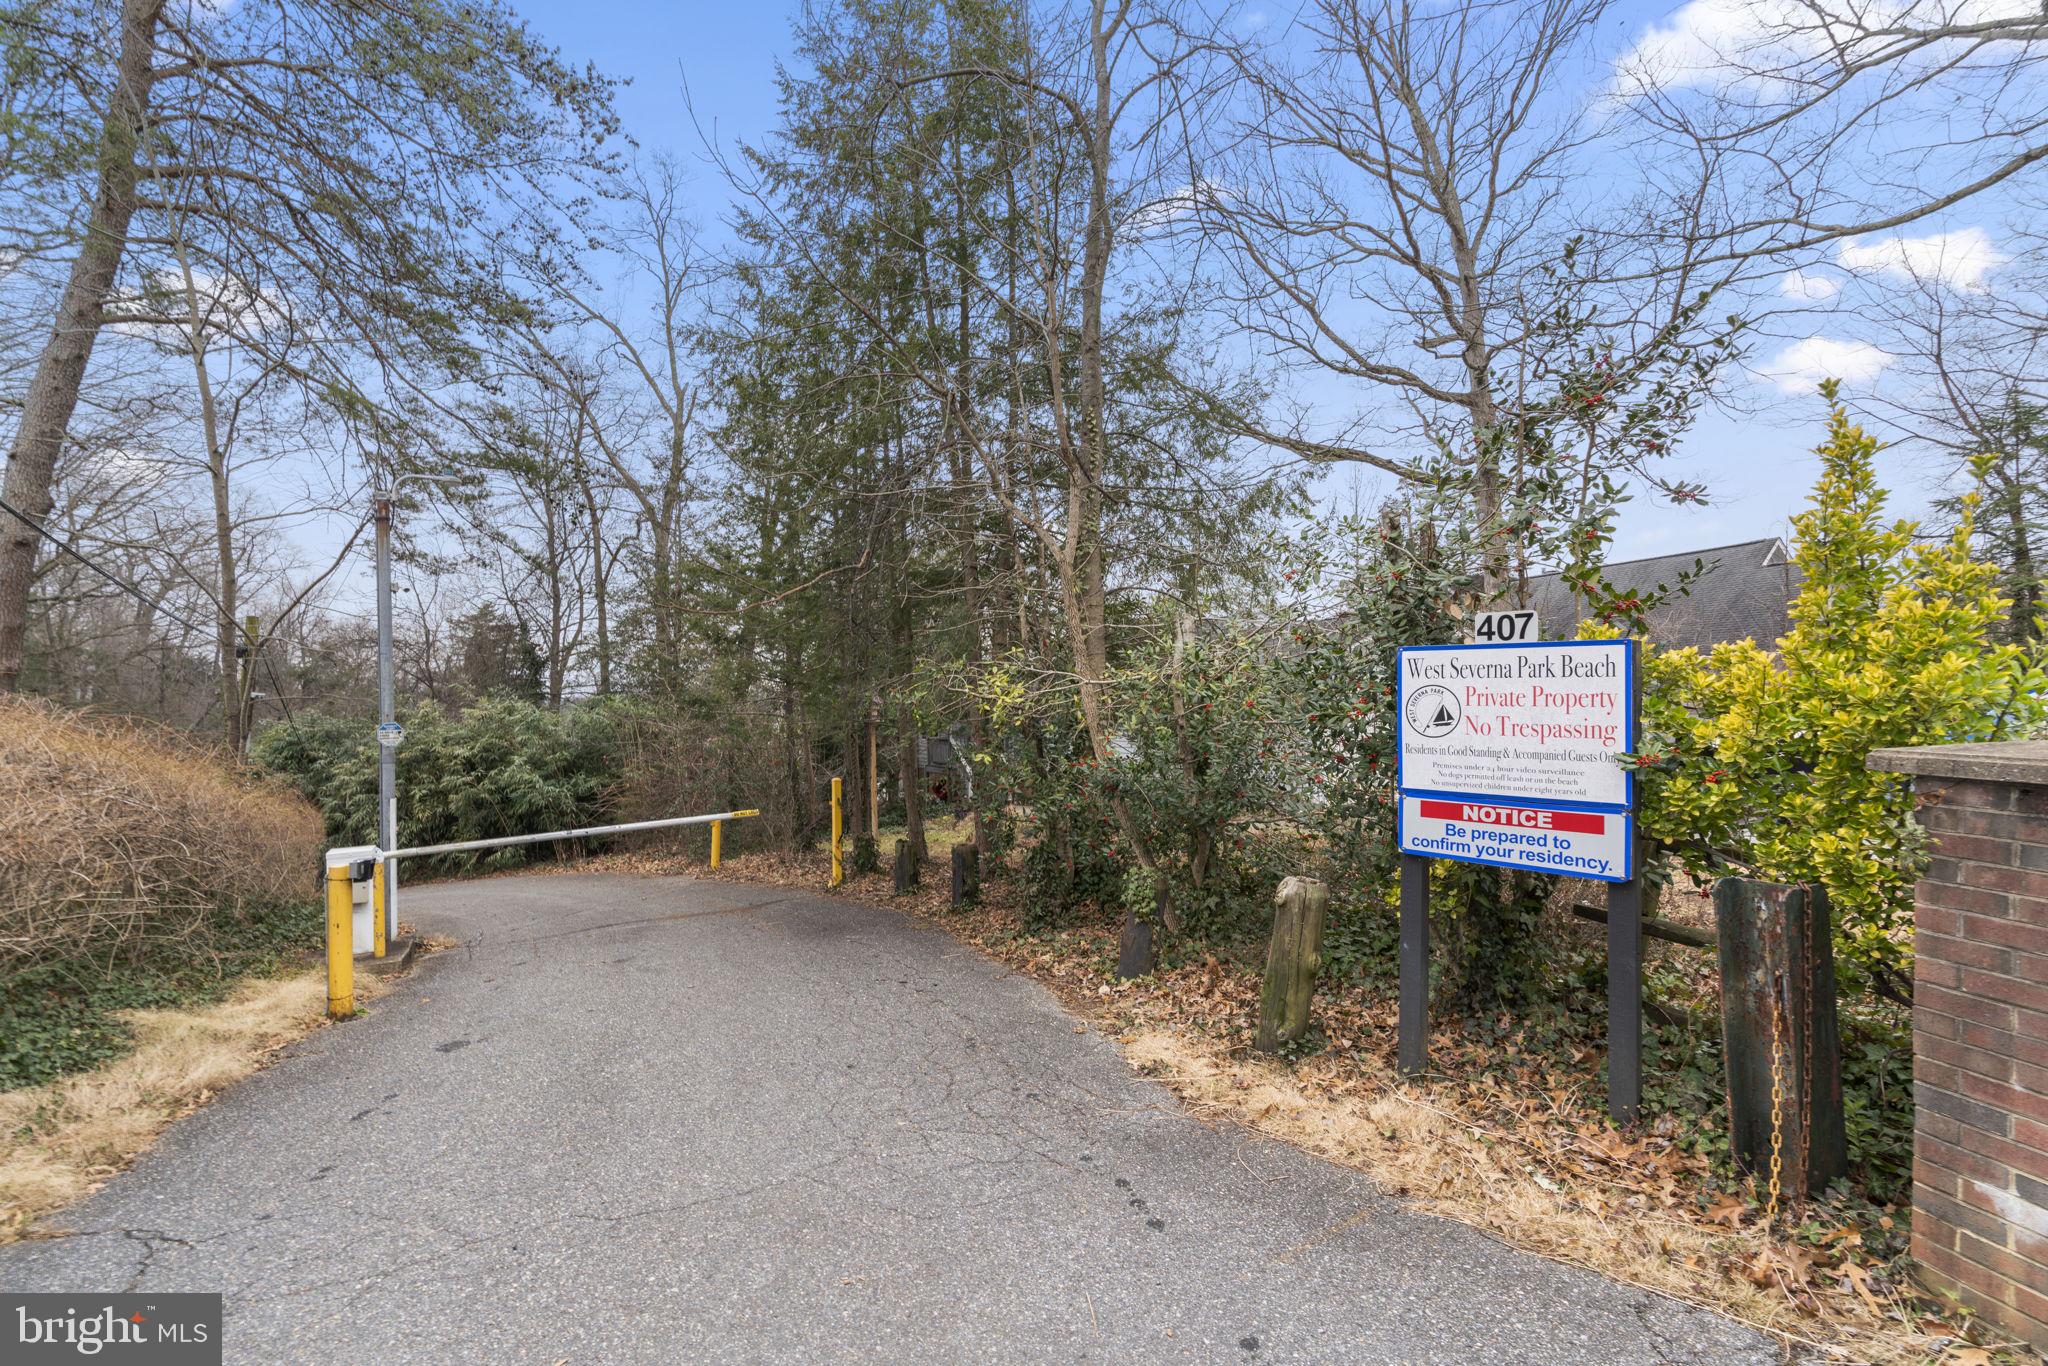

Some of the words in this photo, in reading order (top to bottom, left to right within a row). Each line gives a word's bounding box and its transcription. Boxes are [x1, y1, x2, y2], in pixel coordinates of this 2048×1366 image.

[1477, 613, 1534, 641] 407
[1407, 657, 1446, 679] West
[1450, 656, 1512, 679] Severna
[1517, 655, 1556, 678] Park
[1561, 654, 1616, 678] Beach
[1465, 685, 1526, 708] Private
[1531, 685, 1617, 715] Property
[1465, 715, 1491, 736] No
[1496, 715, 1618, 747] Trespassing
[1405, 743, 1437, 755] Residents
[1439, 744, 1447, 755] in
[1447, 745, 1468, 757] Good
[1469, 745, 1502, 761] Standing
[1503, 747, 1510, 759] &
[1513, 748, 1566, 763] Accompanied
[1568, 750, 1597, 762] Guests
[1432, 762, 1462, 770] Premises
[1448, 771, 1463, 779] dogs
[1484, 782, 1512, 790] children
[1534, 786, 1552, 794] eight
[1554, 788, 1573, 796] years
[1462, 805, 1553, 829] NOTICE
[1445, 823, 1466, 839] Be
[1471, 827, 1547, 847] prepared
[1553, 834, 1571, 850] to
[1411, 836, 1471, 854] confirm
[1475, 843, 1514, 858] your
[1519, 848, 1613, 873] residency.
